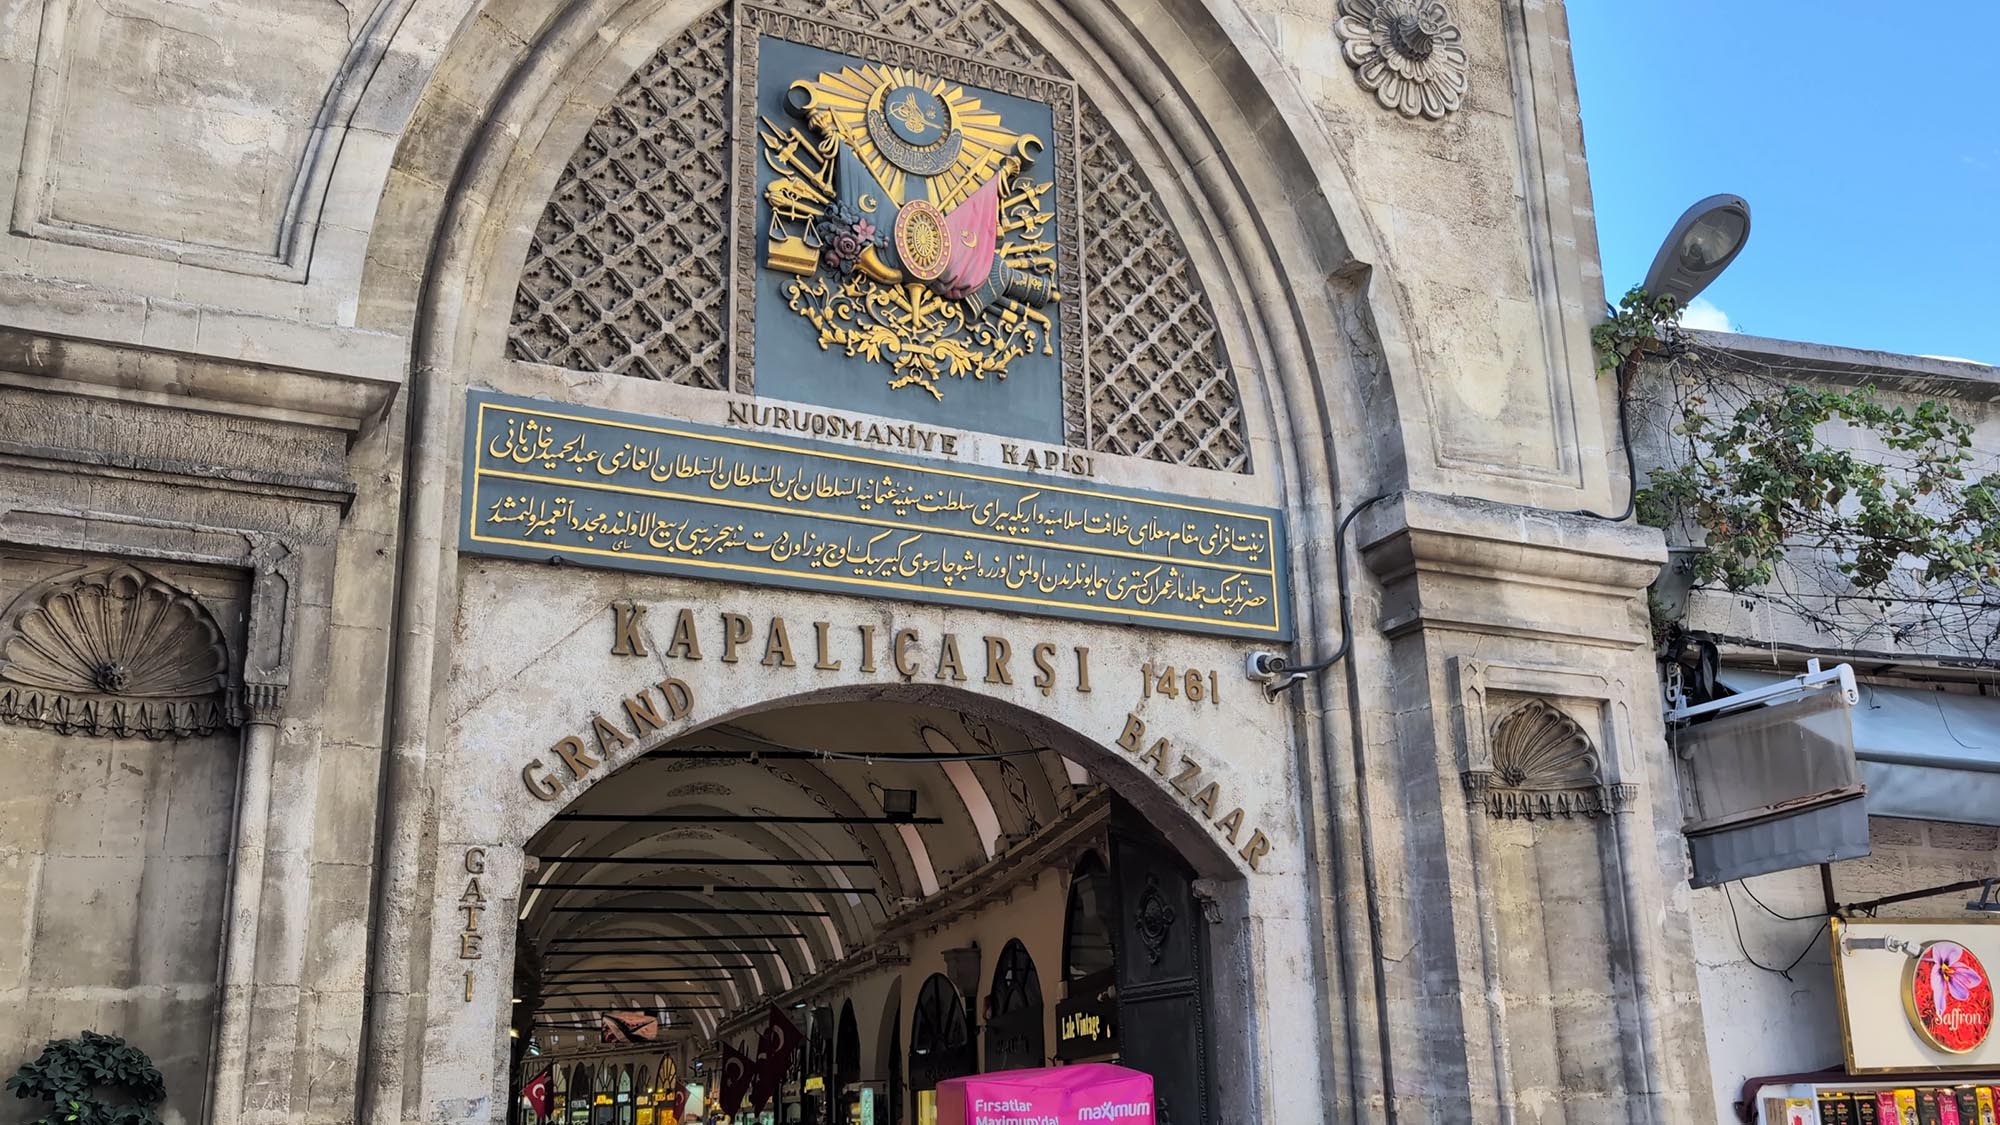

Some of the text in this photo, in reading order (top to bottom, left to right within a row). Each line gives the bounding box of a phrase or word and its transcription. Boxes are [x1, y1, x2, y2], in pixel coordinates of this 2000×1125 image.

[512, 425, 555, 464] خان
[726, 400, 1095, 478] NURUOSMANİYE KAPISI
[769, 467, 803, 502] ابن
[916, 490, 975, 512] سلطنت
[1141, 663, 1220, 704] 1461
[522, 677, 1271, 871] GRAND BAZAAR
[458, 847, 487, 960] GATE
[1935, 1007, 1982, 1031] Saffron
[975, 1099, 1033, 1112] Fırsatlar
